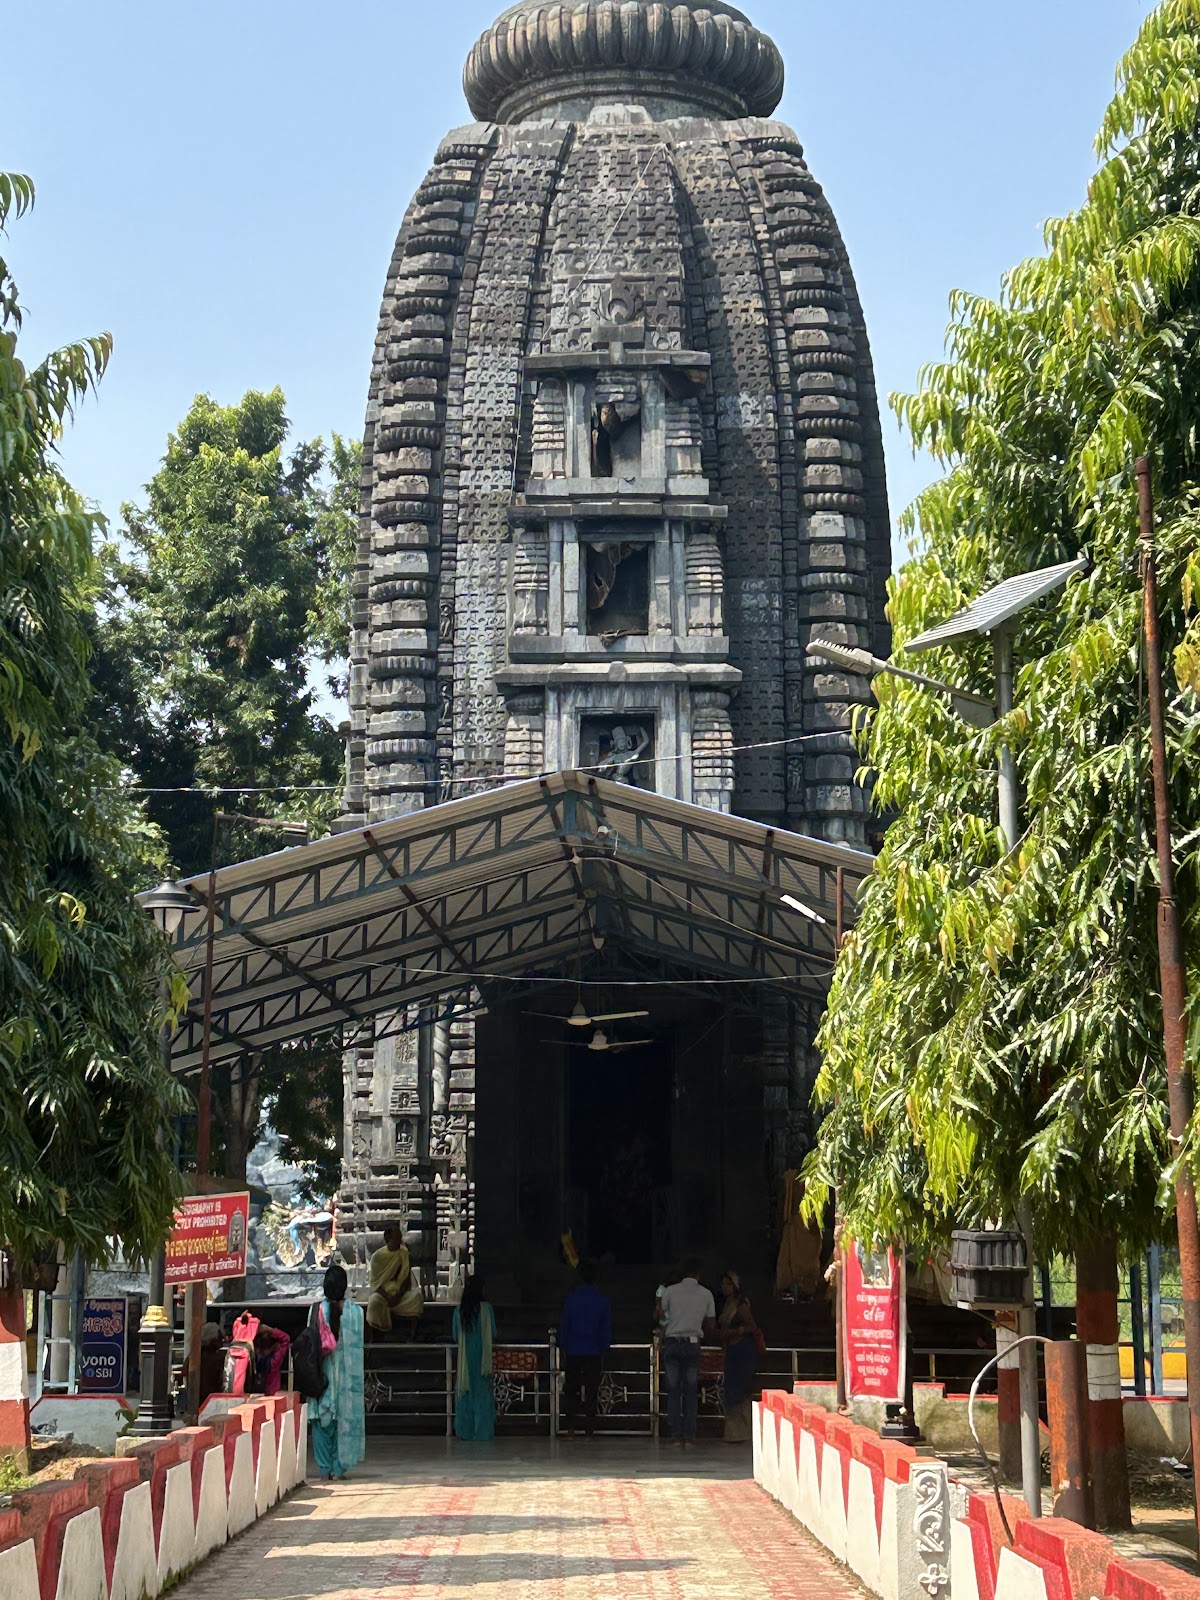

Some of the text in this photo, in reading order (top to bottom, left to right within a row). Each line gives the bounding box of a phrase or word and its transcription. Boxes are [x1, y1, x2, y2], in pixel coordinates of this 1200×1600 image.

[215, 1201, 221, 1212] IS
[192, 1214, 227, 1228] PROHIBITED
[82, 1355, 116, 1369] yono
[96, 1368, 112, 1378] SBI
